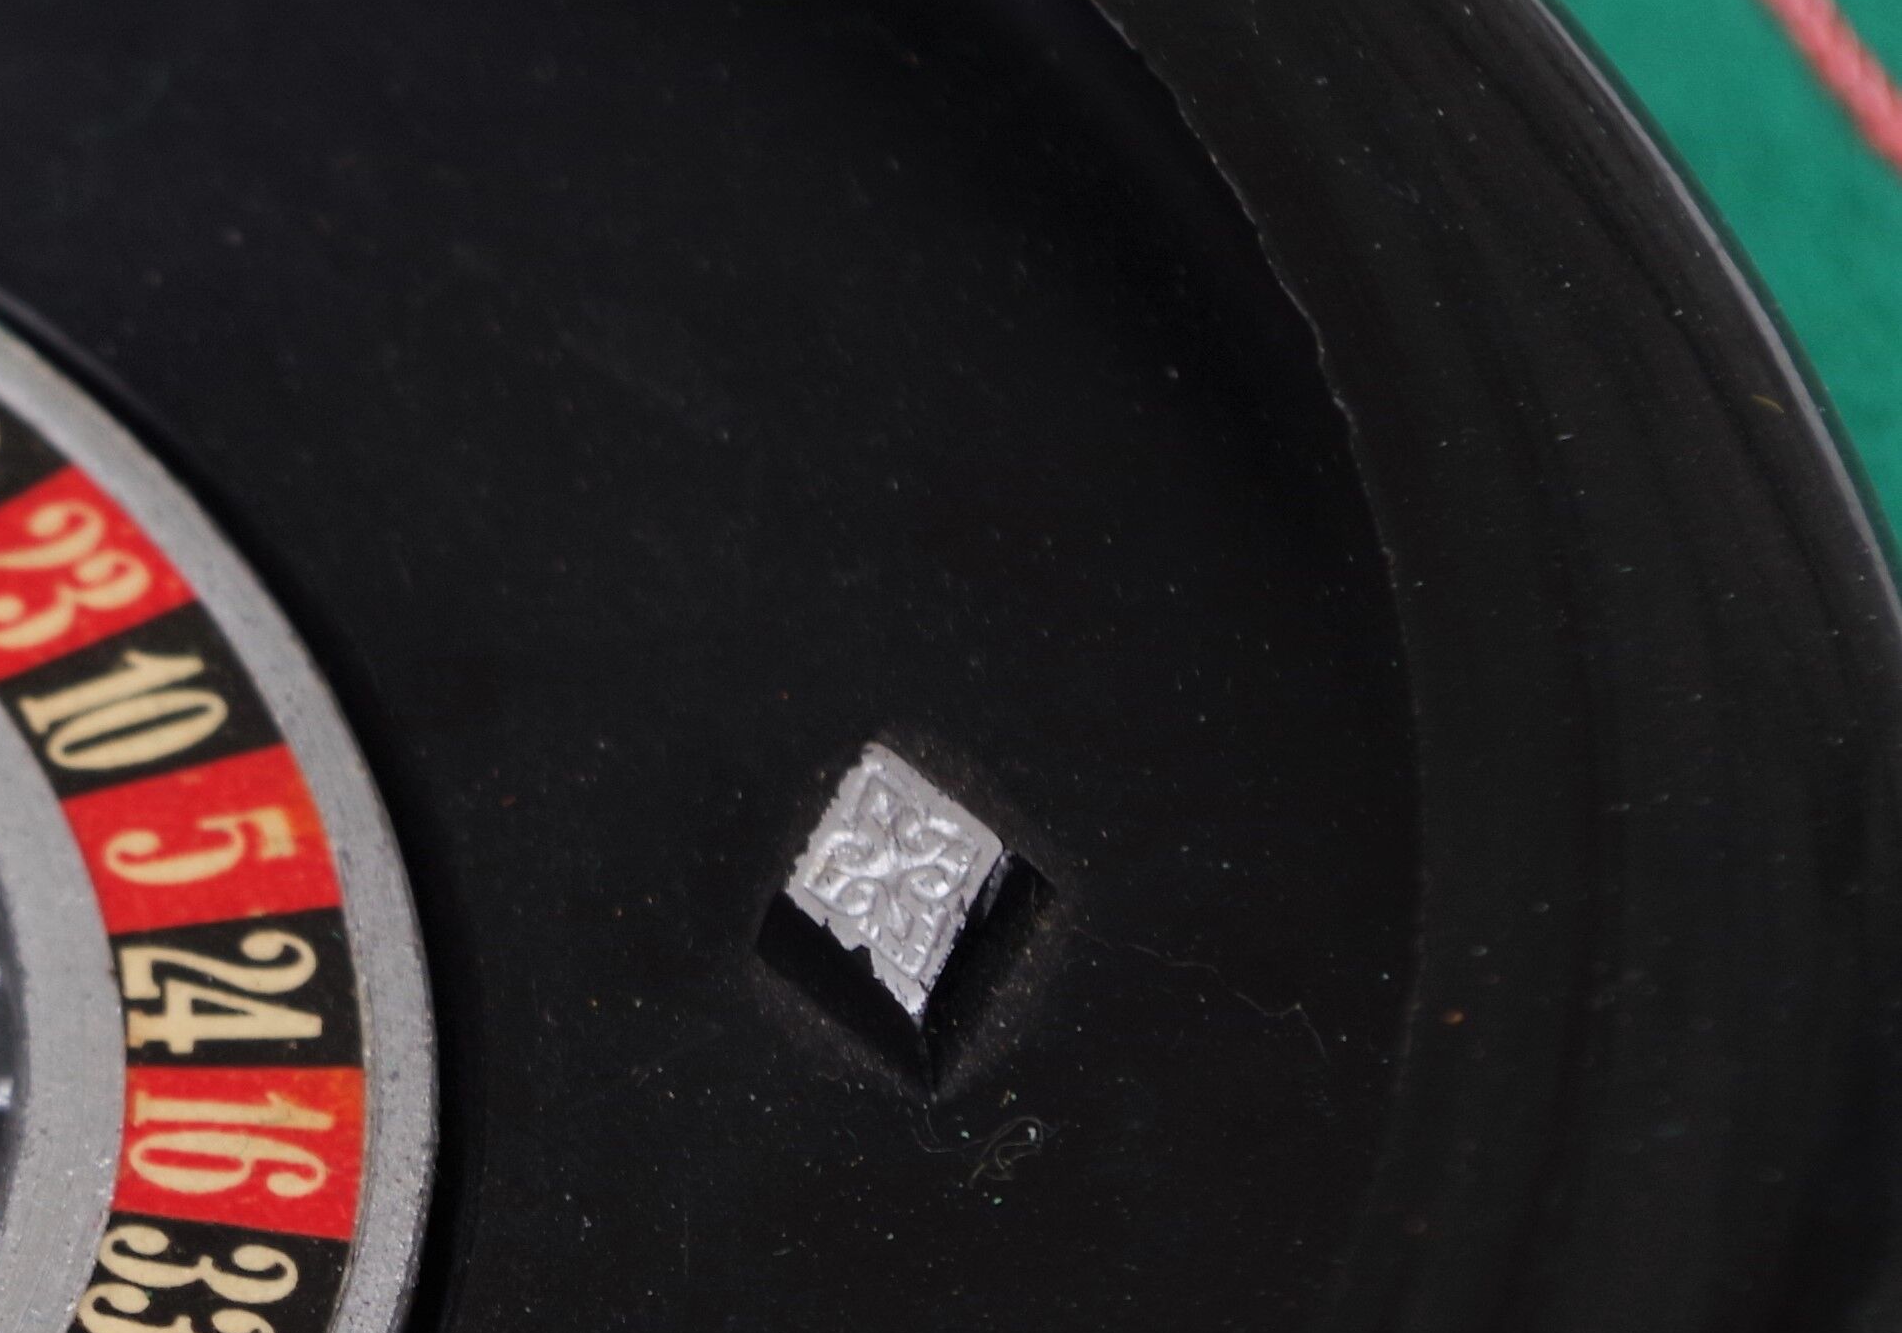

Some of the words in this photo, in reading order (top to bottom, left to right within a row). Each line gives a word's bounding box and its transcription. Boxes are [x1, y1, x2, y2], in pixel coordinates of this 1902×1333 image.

[20, 650, 229, 772] 10
[104, 807, 297, 887] 5
[119, 929, 323, 1055] 24
[129, 1090, 337, 1199] 16
